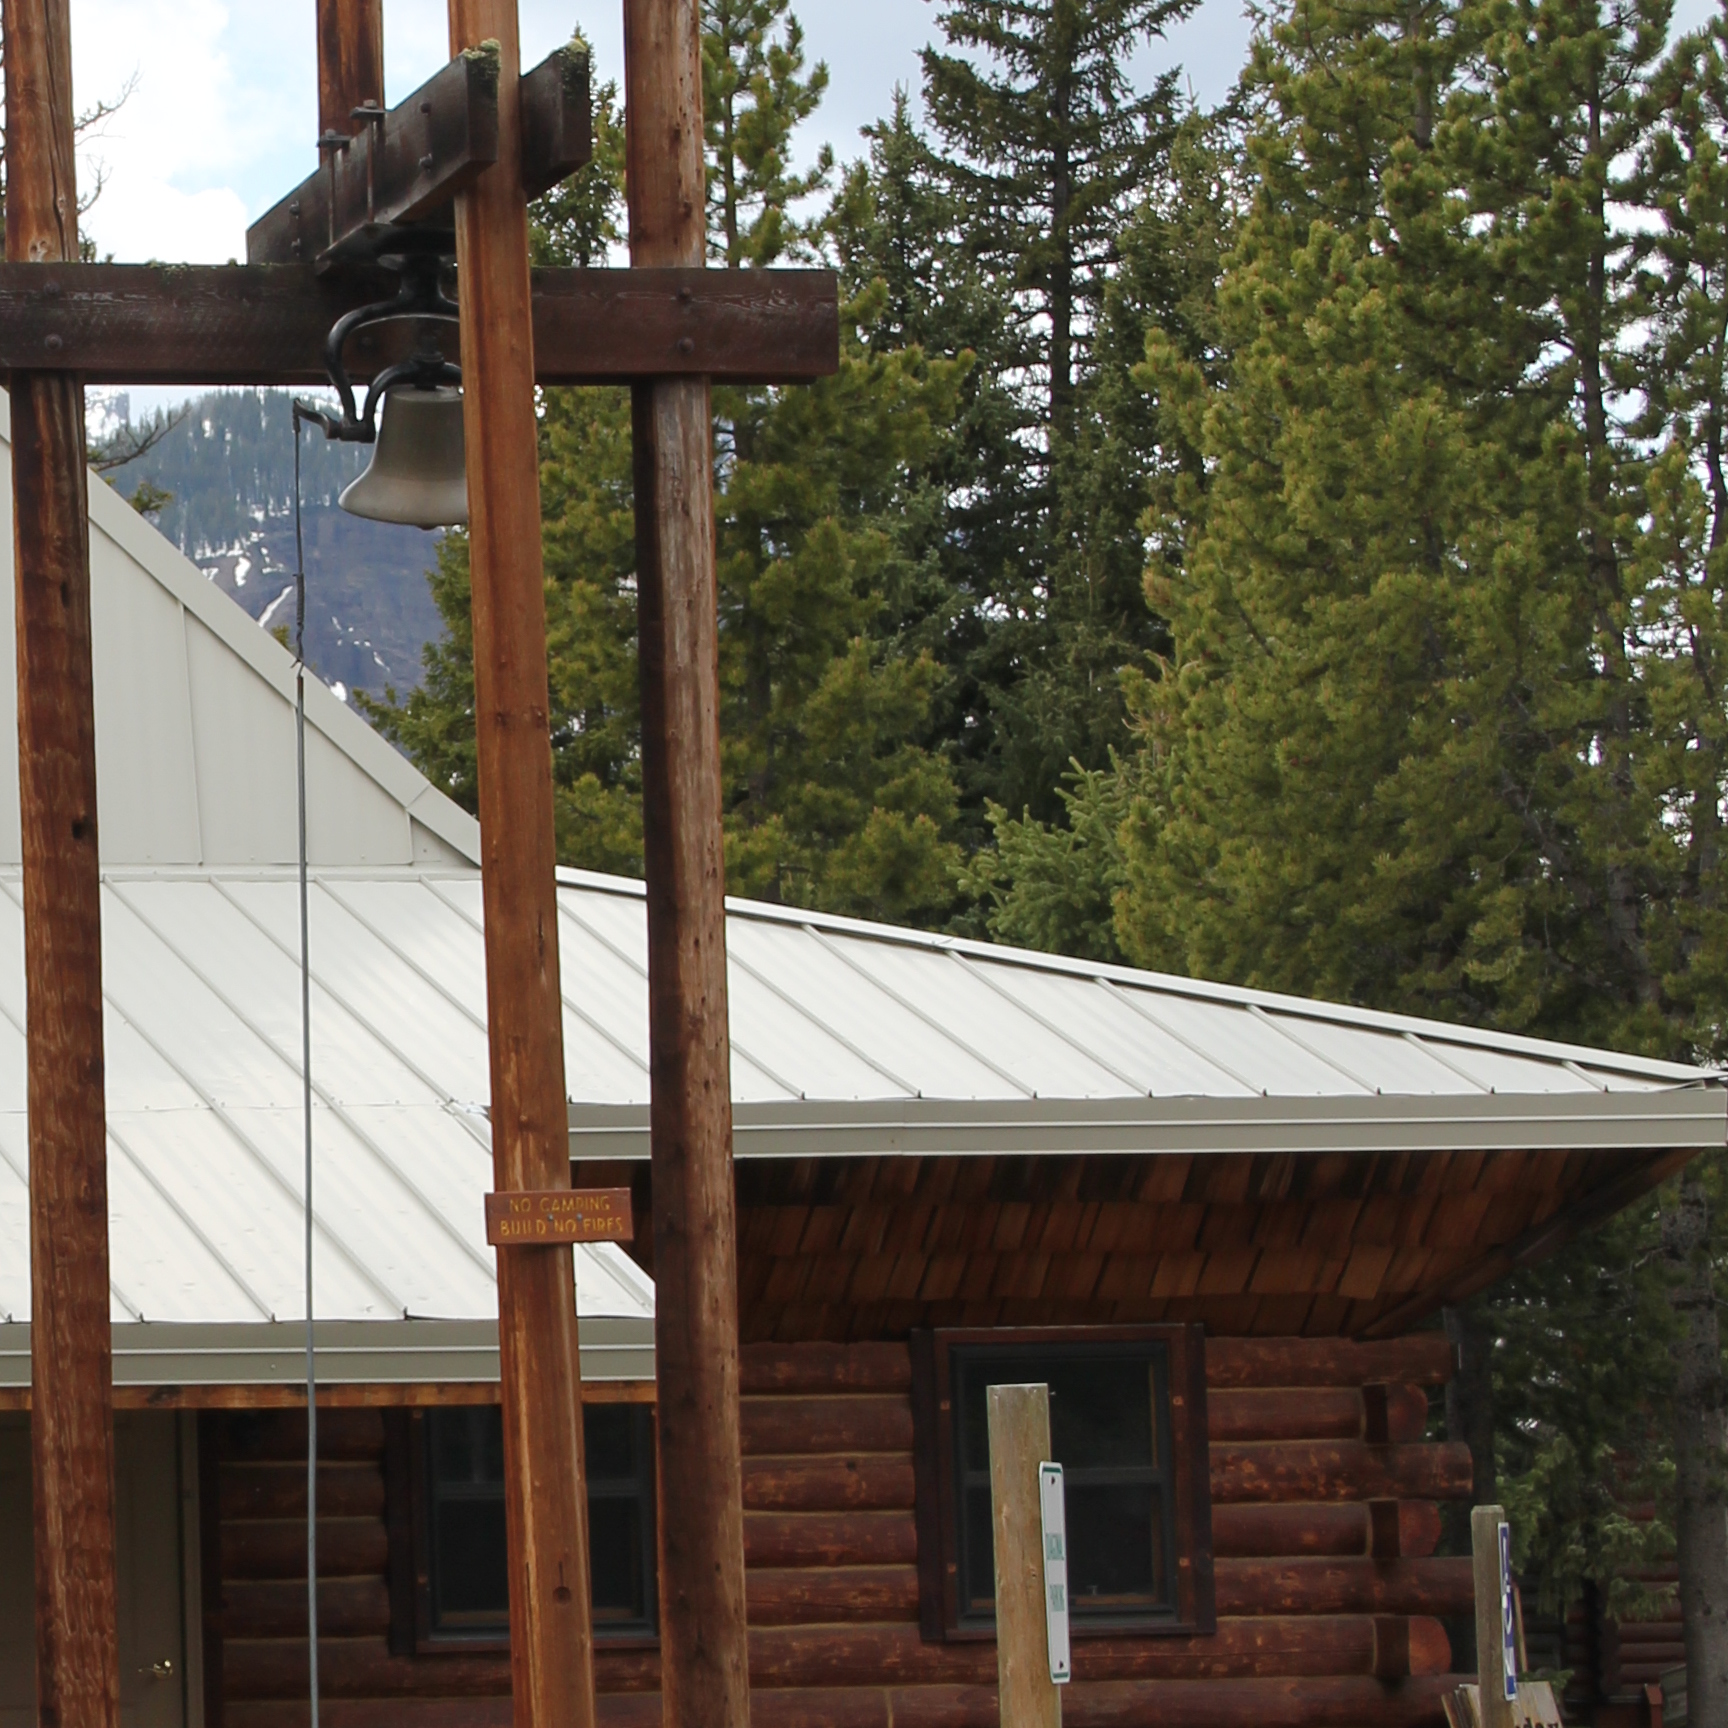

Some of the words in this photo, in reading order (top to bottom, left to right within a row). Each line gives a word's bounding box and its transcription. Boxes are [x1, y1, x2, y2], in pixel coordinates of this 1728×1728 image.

[510, 1197, 531, 1212] NO
[539, 1196, 610, 1212] CAMPING
[500, 1219, 546, 1236] BUILD
[554, 1219, 576, 1233] NO
[583, 1217, 623, 1233] FIRES
